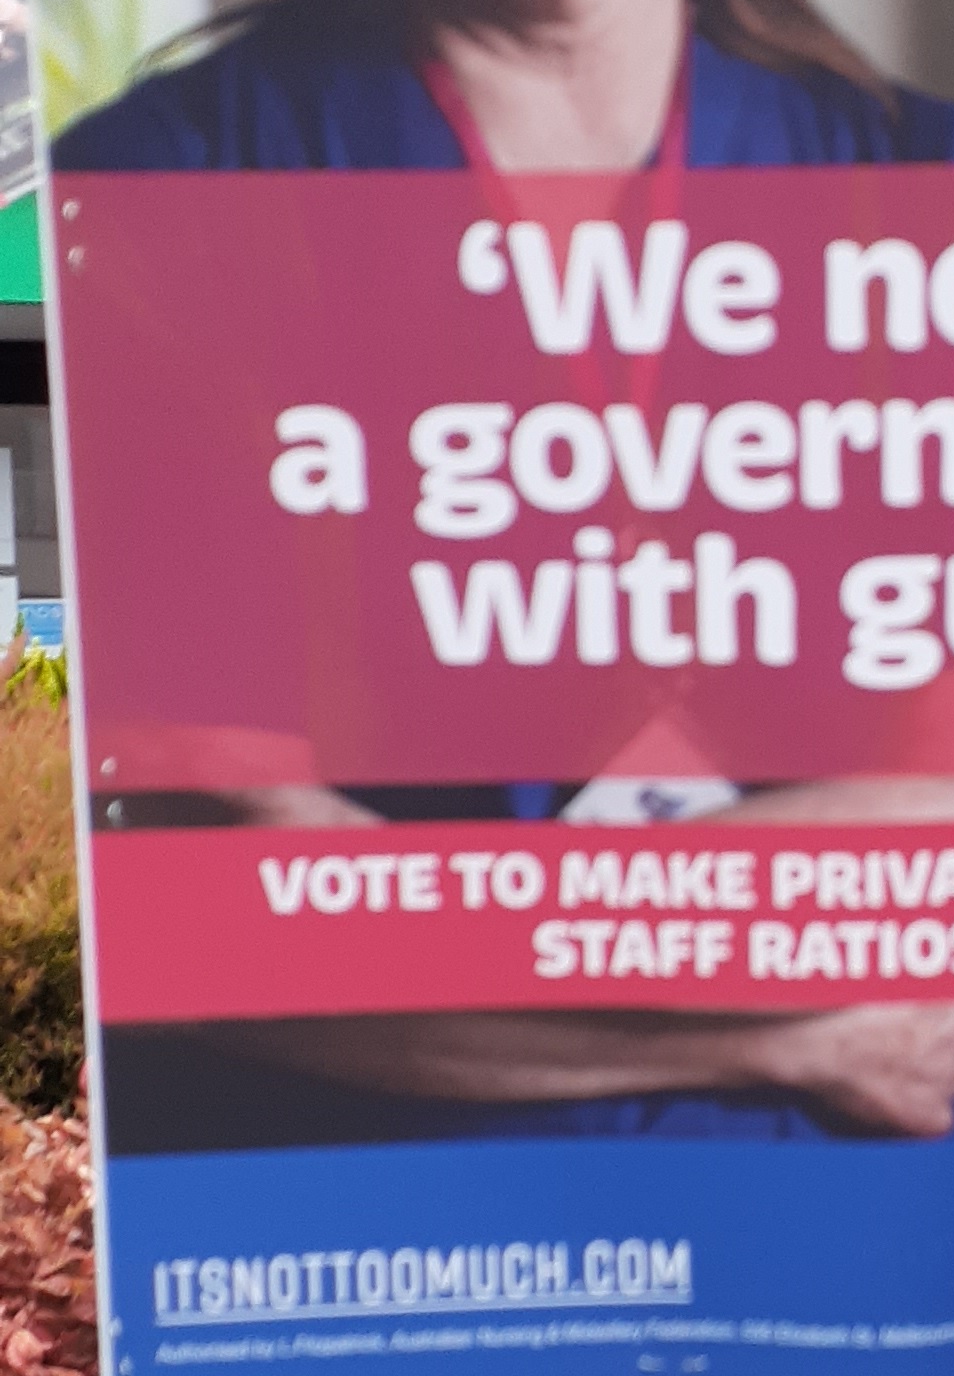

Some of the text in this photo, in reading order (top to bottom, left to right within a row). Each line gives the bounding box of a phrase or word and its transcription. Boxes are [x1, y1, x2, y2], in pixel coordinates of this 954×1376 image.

[268, 403, 369, 516] a
[410, 525, 798, 668] with
[259, 853, 442, 916] VOTE
[448, 851, 547, 910] TO
[557, 850, 759, 910] MAKE
[531, 919, 734, 979] STAFF
[153, 1238, 693, 1318] ITSNOTTOOMUCH.COM
